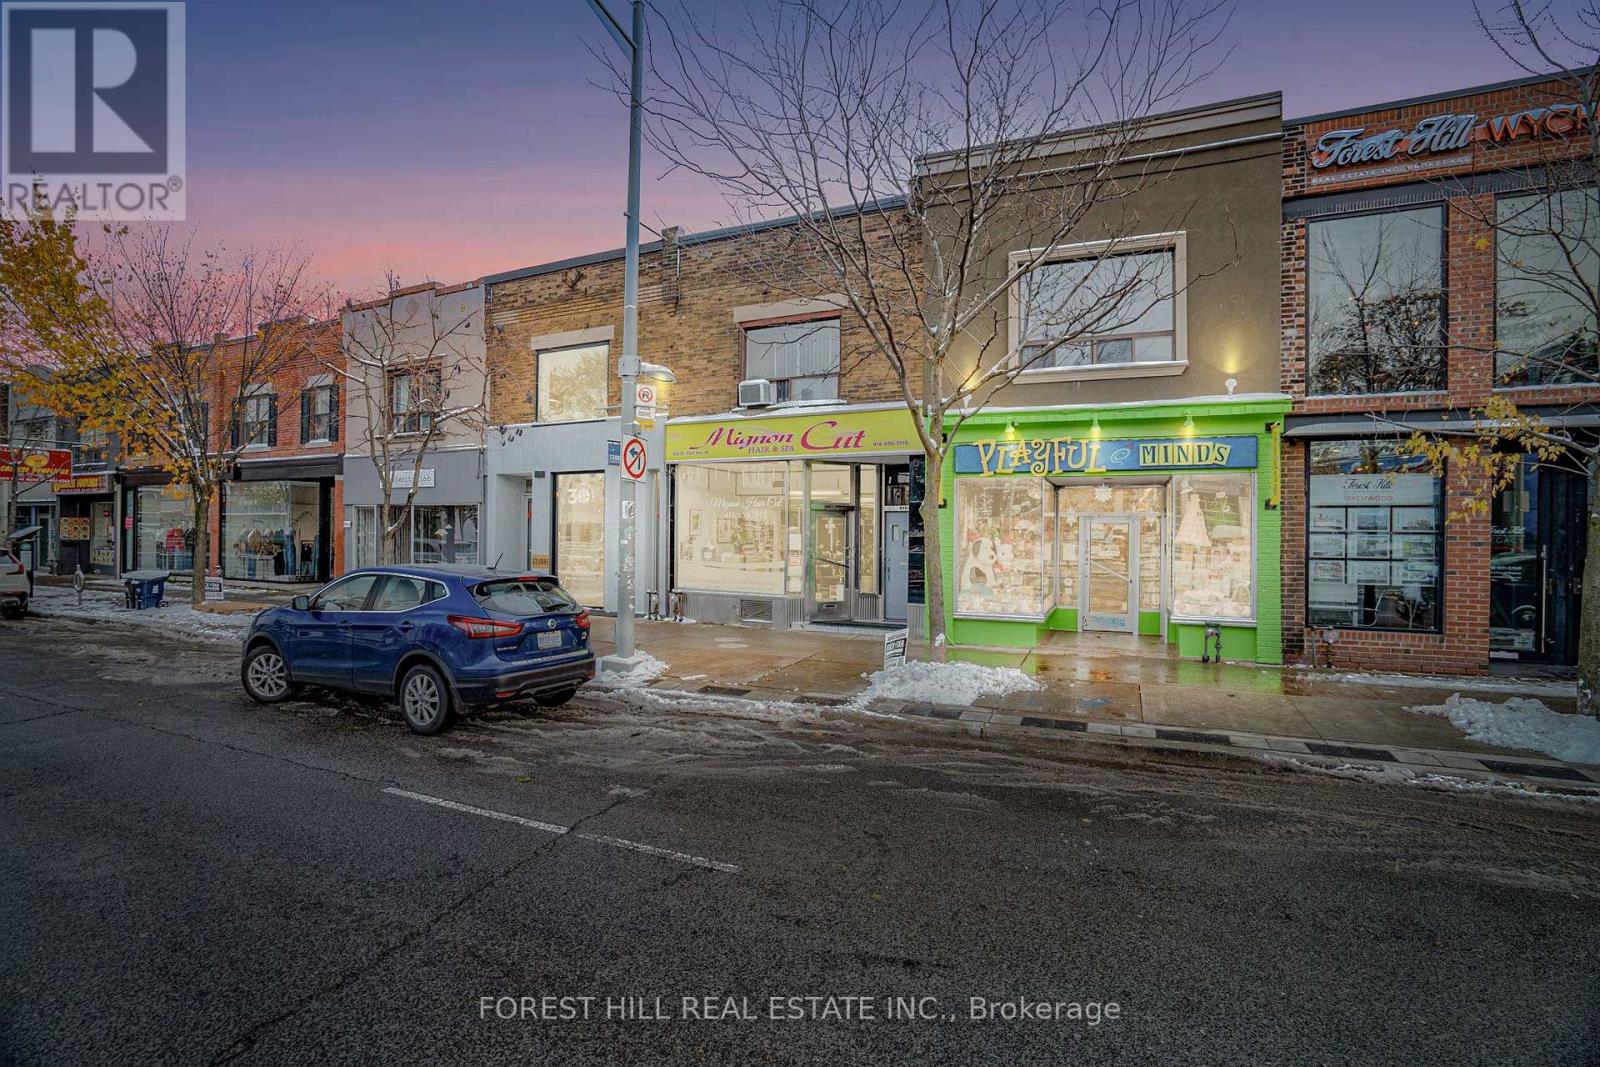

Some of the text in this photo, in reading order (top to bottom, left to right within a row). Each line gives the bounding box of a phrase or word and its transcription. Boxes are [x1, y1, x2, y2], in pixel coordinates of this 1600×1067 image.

[1310, 127, 1406, 170] Forest
[1407, 113, 1479, 156] Hill
[696, 420, 866, 451] Mignon Cut
[748, 446, 770, 454] HAIR
[780, 445, 795, 453] SPA
[973, 436, 1230, 478] PLAYFUL MINDS
